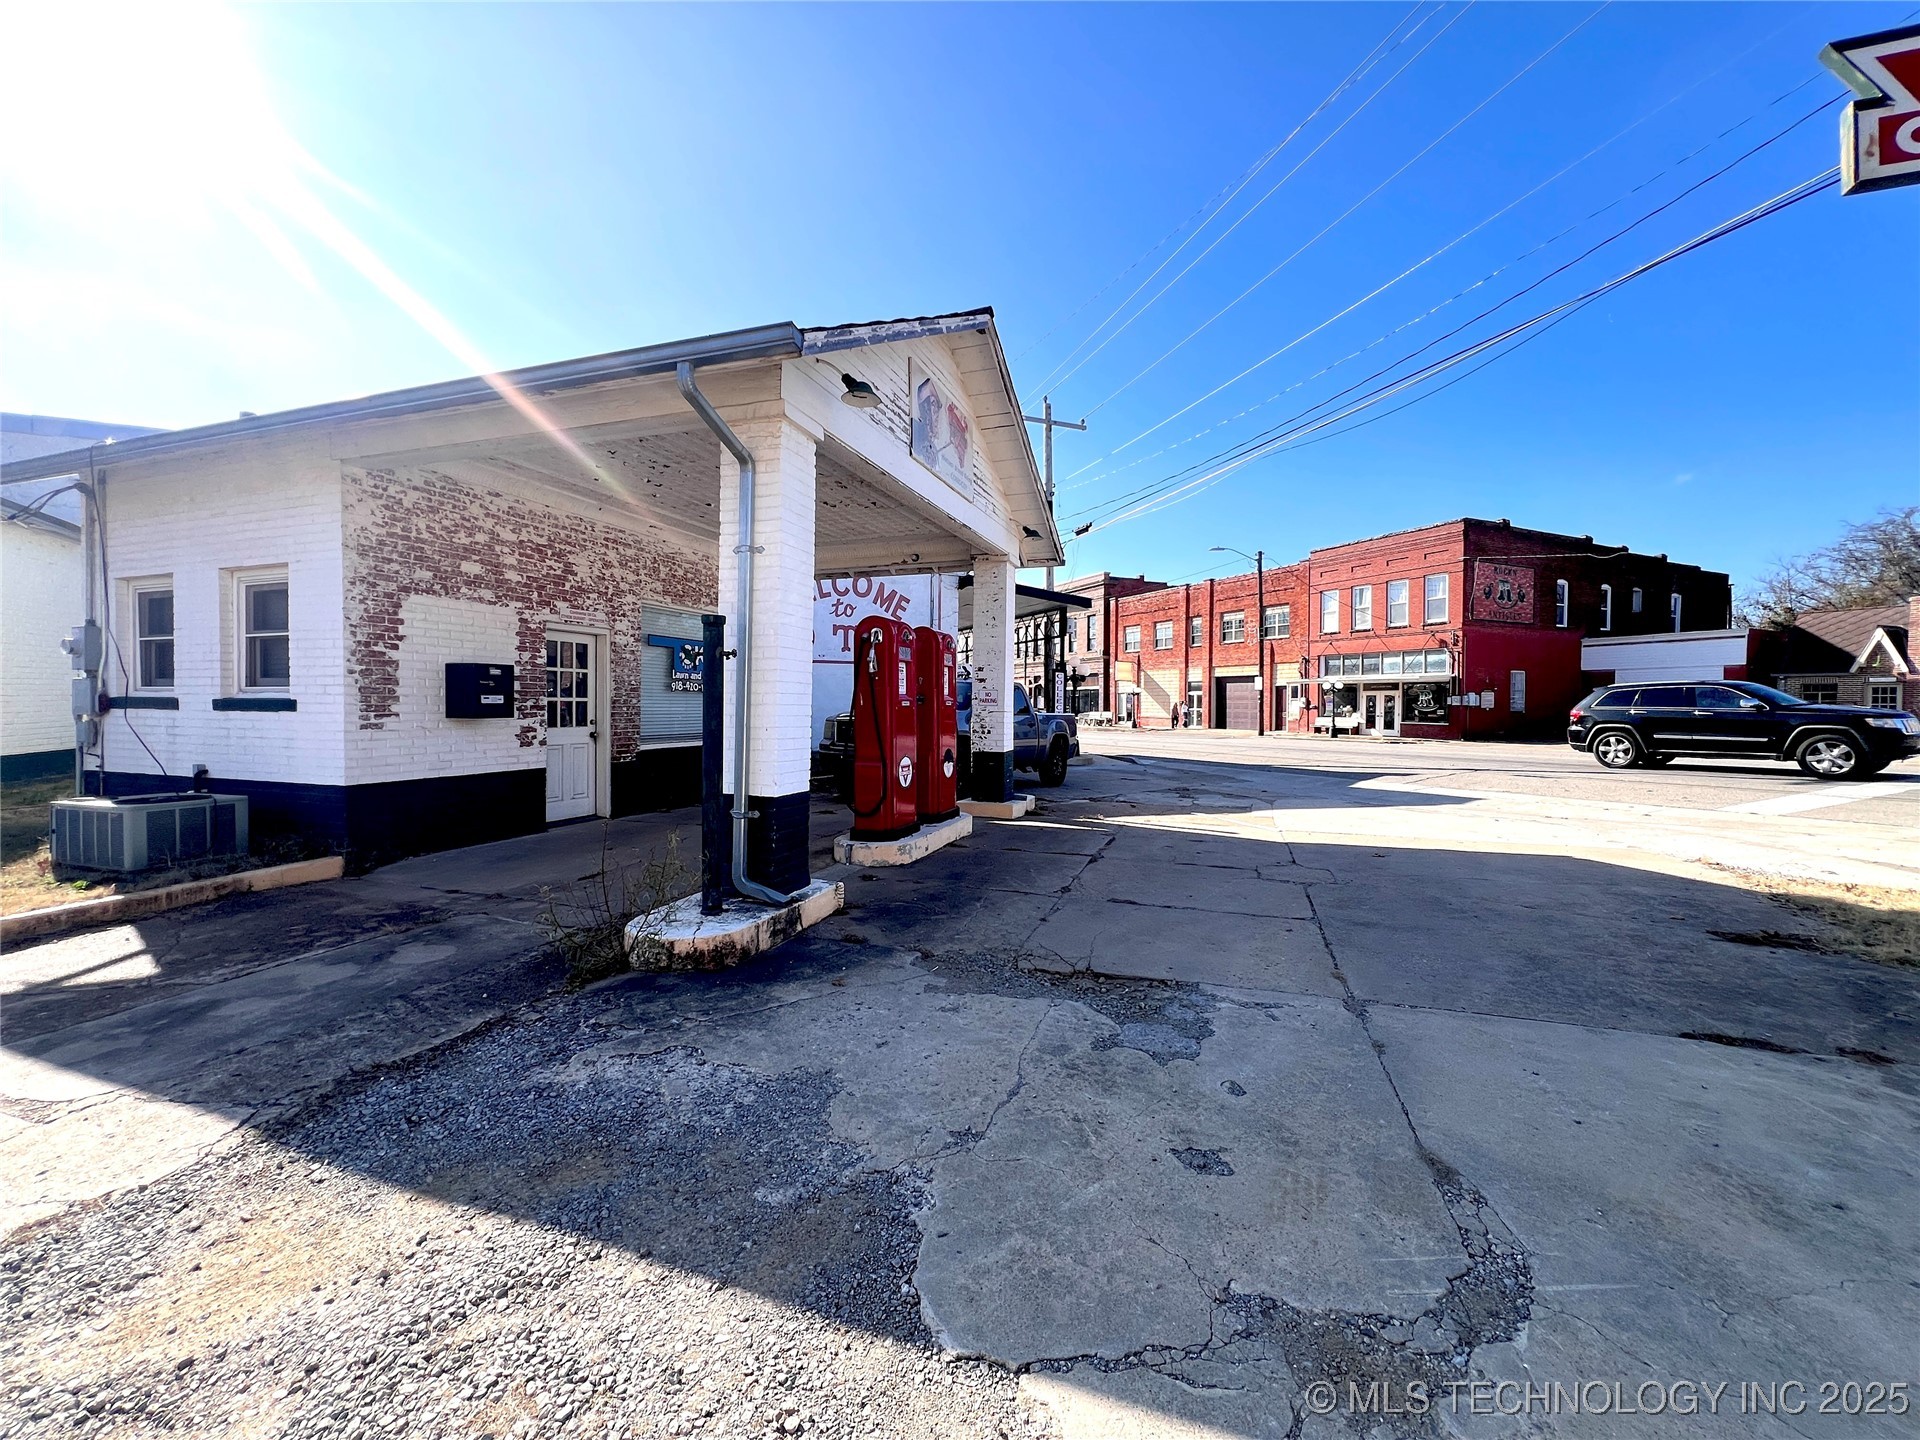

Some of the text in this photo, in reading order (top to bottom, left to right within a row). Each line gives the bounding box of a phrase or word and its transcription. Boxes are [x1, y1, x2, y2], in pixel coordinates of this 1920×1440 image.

[814, 577, 910, 621] LCOME
[829, 598, 857, 618] to
[672, 669, 702, 680] Lawn and
